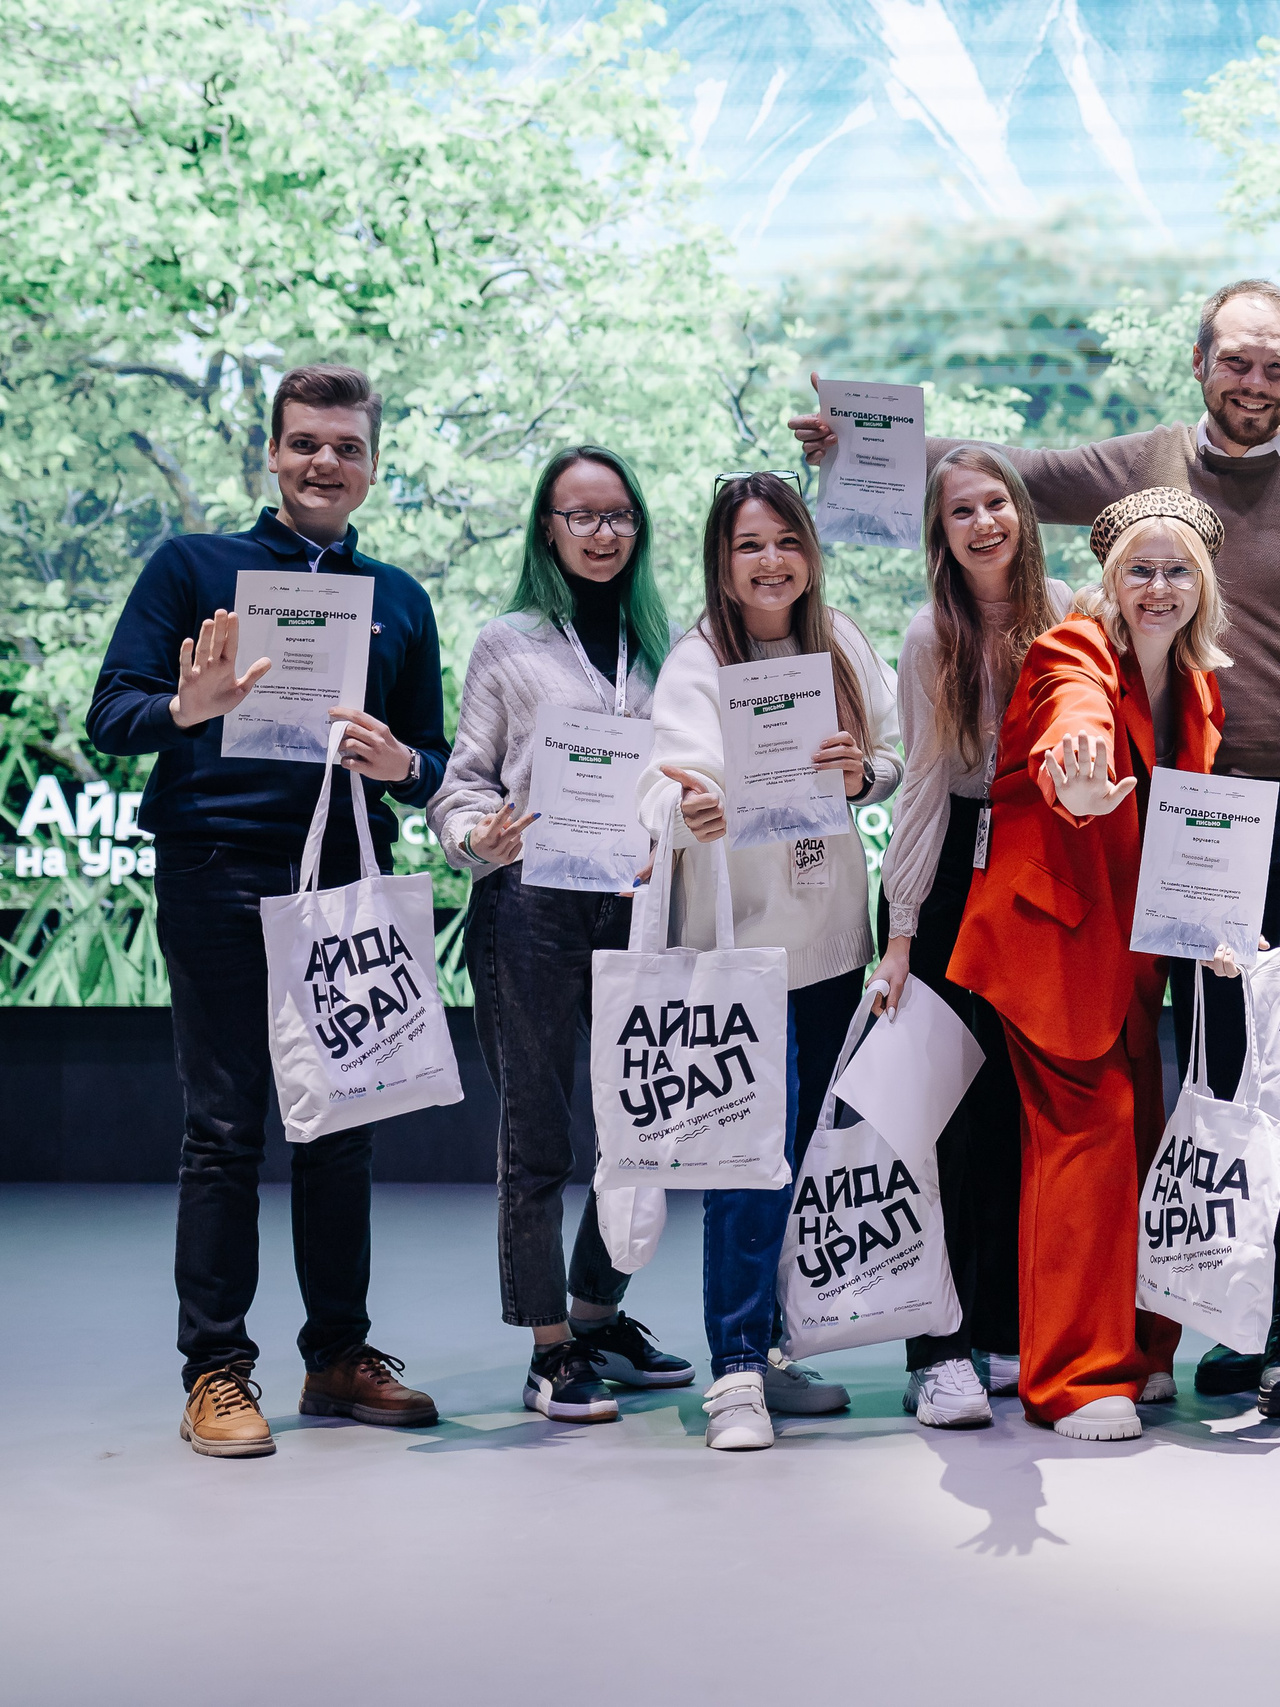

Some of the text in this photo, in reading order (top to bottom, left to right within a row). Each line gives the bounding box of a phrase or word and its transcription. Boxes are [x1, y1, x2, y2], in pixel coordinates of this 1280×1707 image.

[830, 407, 914, 424] Благодарственное
[248, 604, 358, 620] Благодарственное
[730, 689, 821, 709] Благодарственное
[763, 703, 785, 712] письмо
[545, 736, 640, 760] Благодарственное
[17, 775, 155, 840] Айд
[1160, 802, 1260, 824] Благодарственное
[795, 838, 825, 850] АЙДА
[15, 838, 156, 885] на Ура
[796, 850, 824, 869] УРАЛ
[304, 924, 413, 982] АЙДА
[312, 984, 351, 1014] НА
[315, 963, 422, 1060] УРАЛ
[408, 1022, 426, 1042] форум
[616, 1000, 760, 1048] АЙДА
[340, 1042, 382, 1072] Окружной
[623, 1048, 674, 1080] НА
[619, 1044, 756, 1128] УРАЛ
[638, 1092, 756, 1142] Окружной туристический
[718, 1108, 750, 1127] форум
[1156, 1135, 1250, 1200] АЙДА
[793, 1159, 920, 1214] АЙДА
[1152, 1173, 1184, 1206] НА
[799, 1214, 843, 1245] НА
[1144, 1198, 1236, 1250] УРАЛ
[796, 1198, 922, 1288] УРАЛ
[1150, 1246, 1232, 1264] Окружной туристический
[818, 1240, 924, 1301] Окружной туристический
[890, 1255, 920, 1276] форум
[1198, 1258, 1223, 1271] форум
